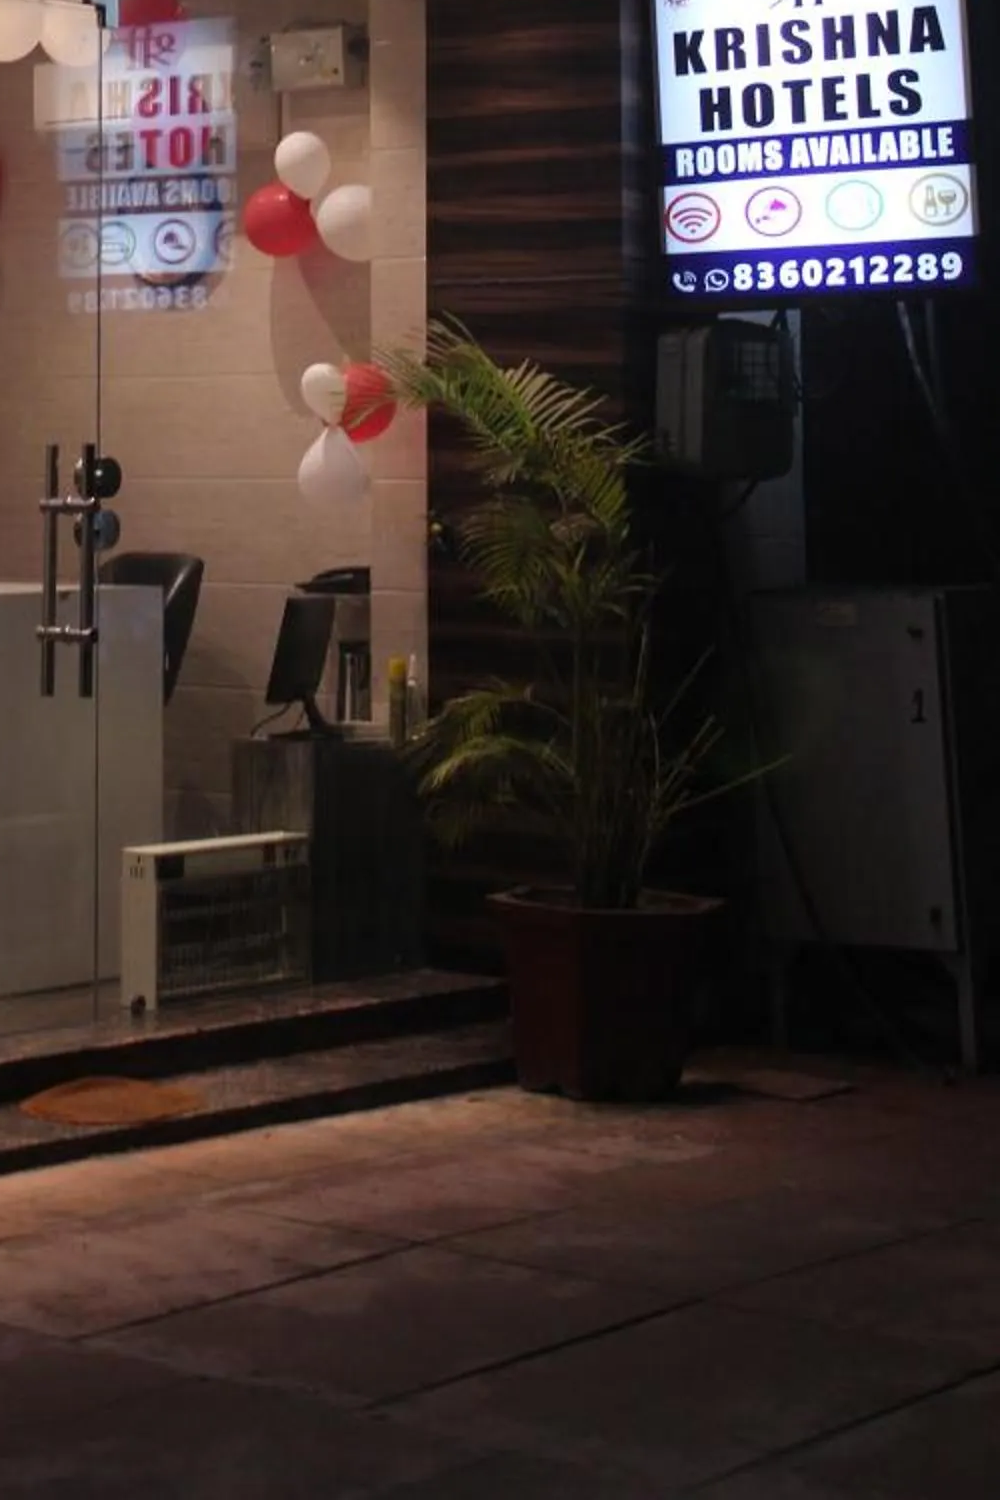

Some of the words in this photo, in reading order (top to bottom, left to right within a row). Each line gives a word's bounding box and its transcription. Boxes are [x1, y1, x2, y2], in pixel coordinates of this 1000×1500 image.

[673, 5, 946, 76] KRISHNA
[700, 69, 922, 132] HOTELS
[676, 140, 783, 178] ROOMS
[790, 127, 954, 170] AVAILABLE
[733, 252, 963, 290] 8360212289
